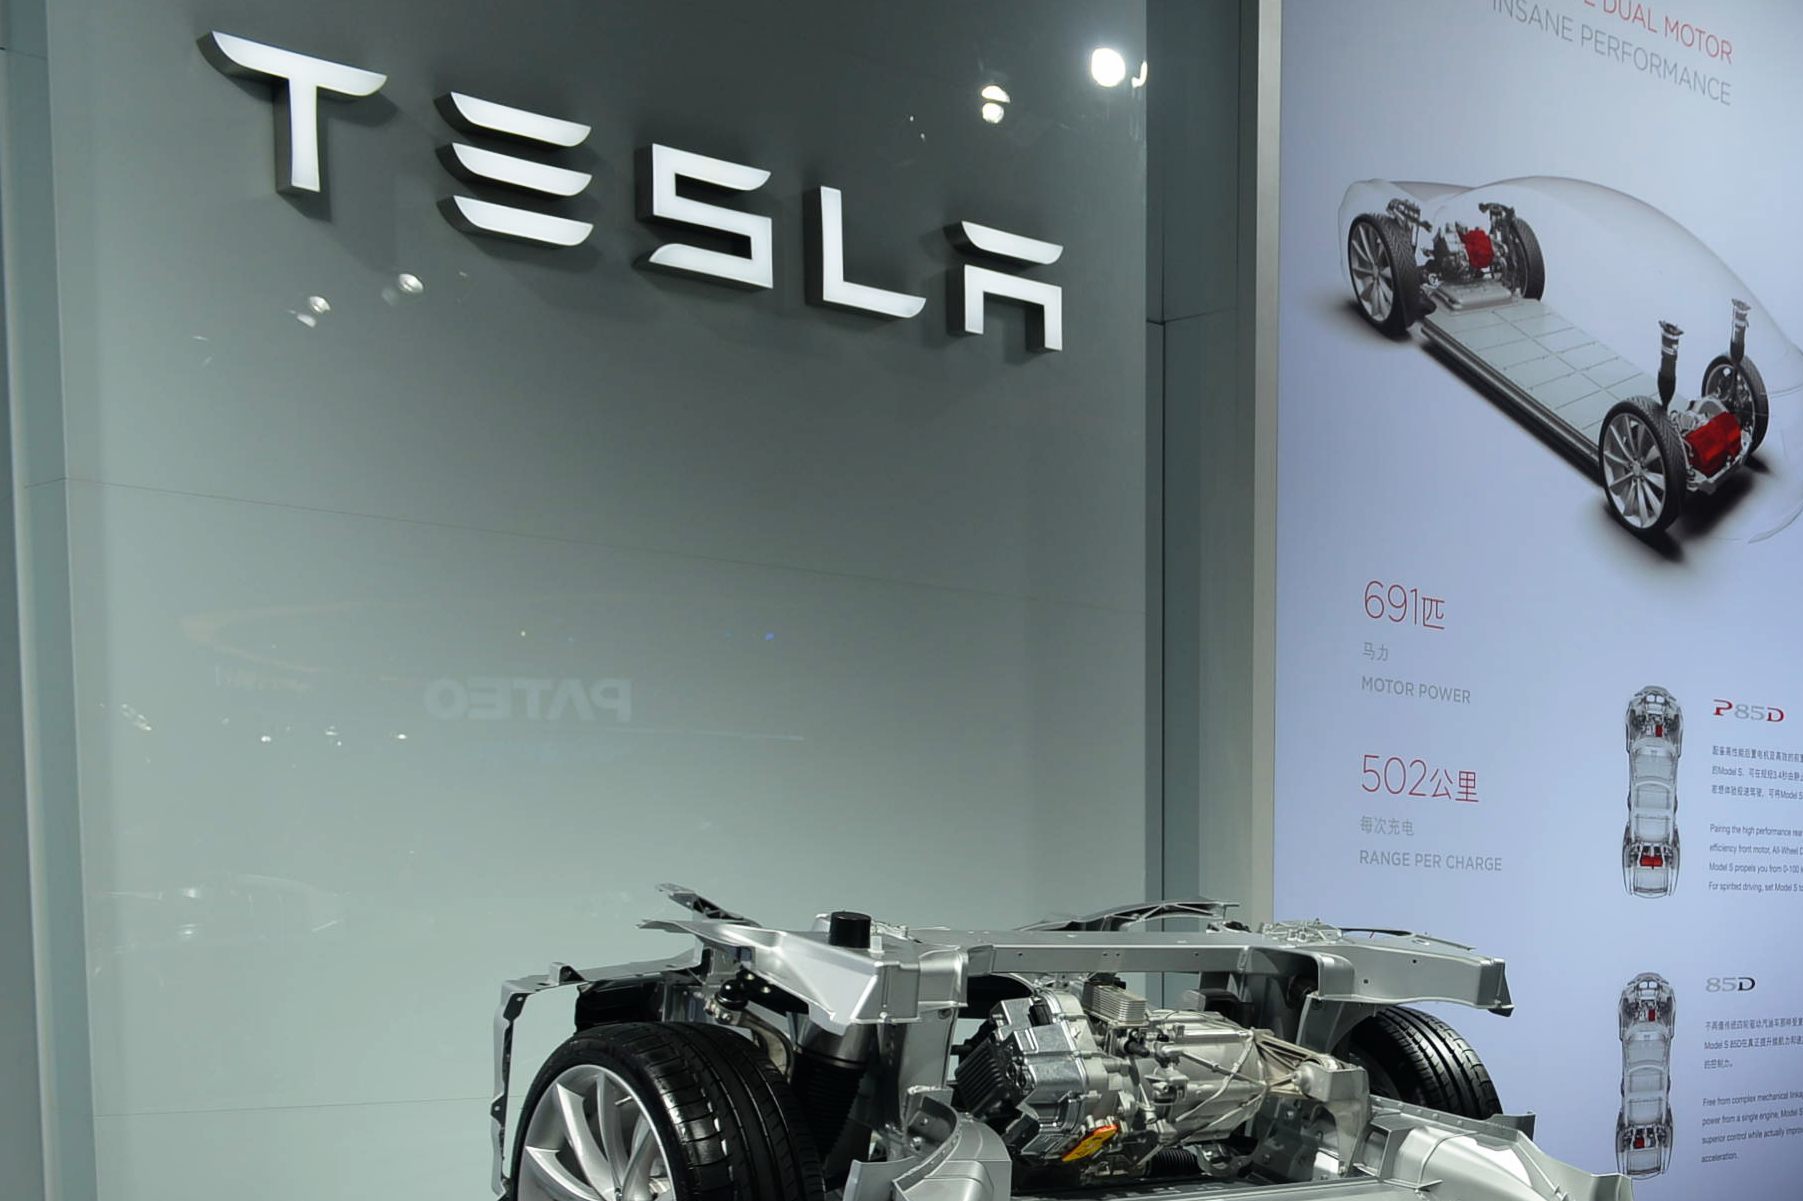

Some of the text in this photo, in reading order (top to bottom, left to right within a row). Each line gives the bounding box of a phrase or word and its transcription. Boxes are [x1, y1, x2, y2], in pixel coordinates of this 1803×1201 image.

[1602, 0, 1733, 64] DUAL MOTOR
[1581, 24, 1732, 106] PERFORMANCE
[197, 31, 1063, 352] TESLA
[1364, 580, 1445, 630] 691匹
[1362, 641, 1389, 661] 马力
[1361, 676, 1471, 704] MOTOR POWER
[1712, 699, 1785, 722] P85D
[1361, 754, 1479, 803] 502公里
[1360, 815, 1415, 837] 每次充电
[1359, 849, 1503, 872] RANGE PER CHARGE
[1706, 977, 1756, 992] 85D
